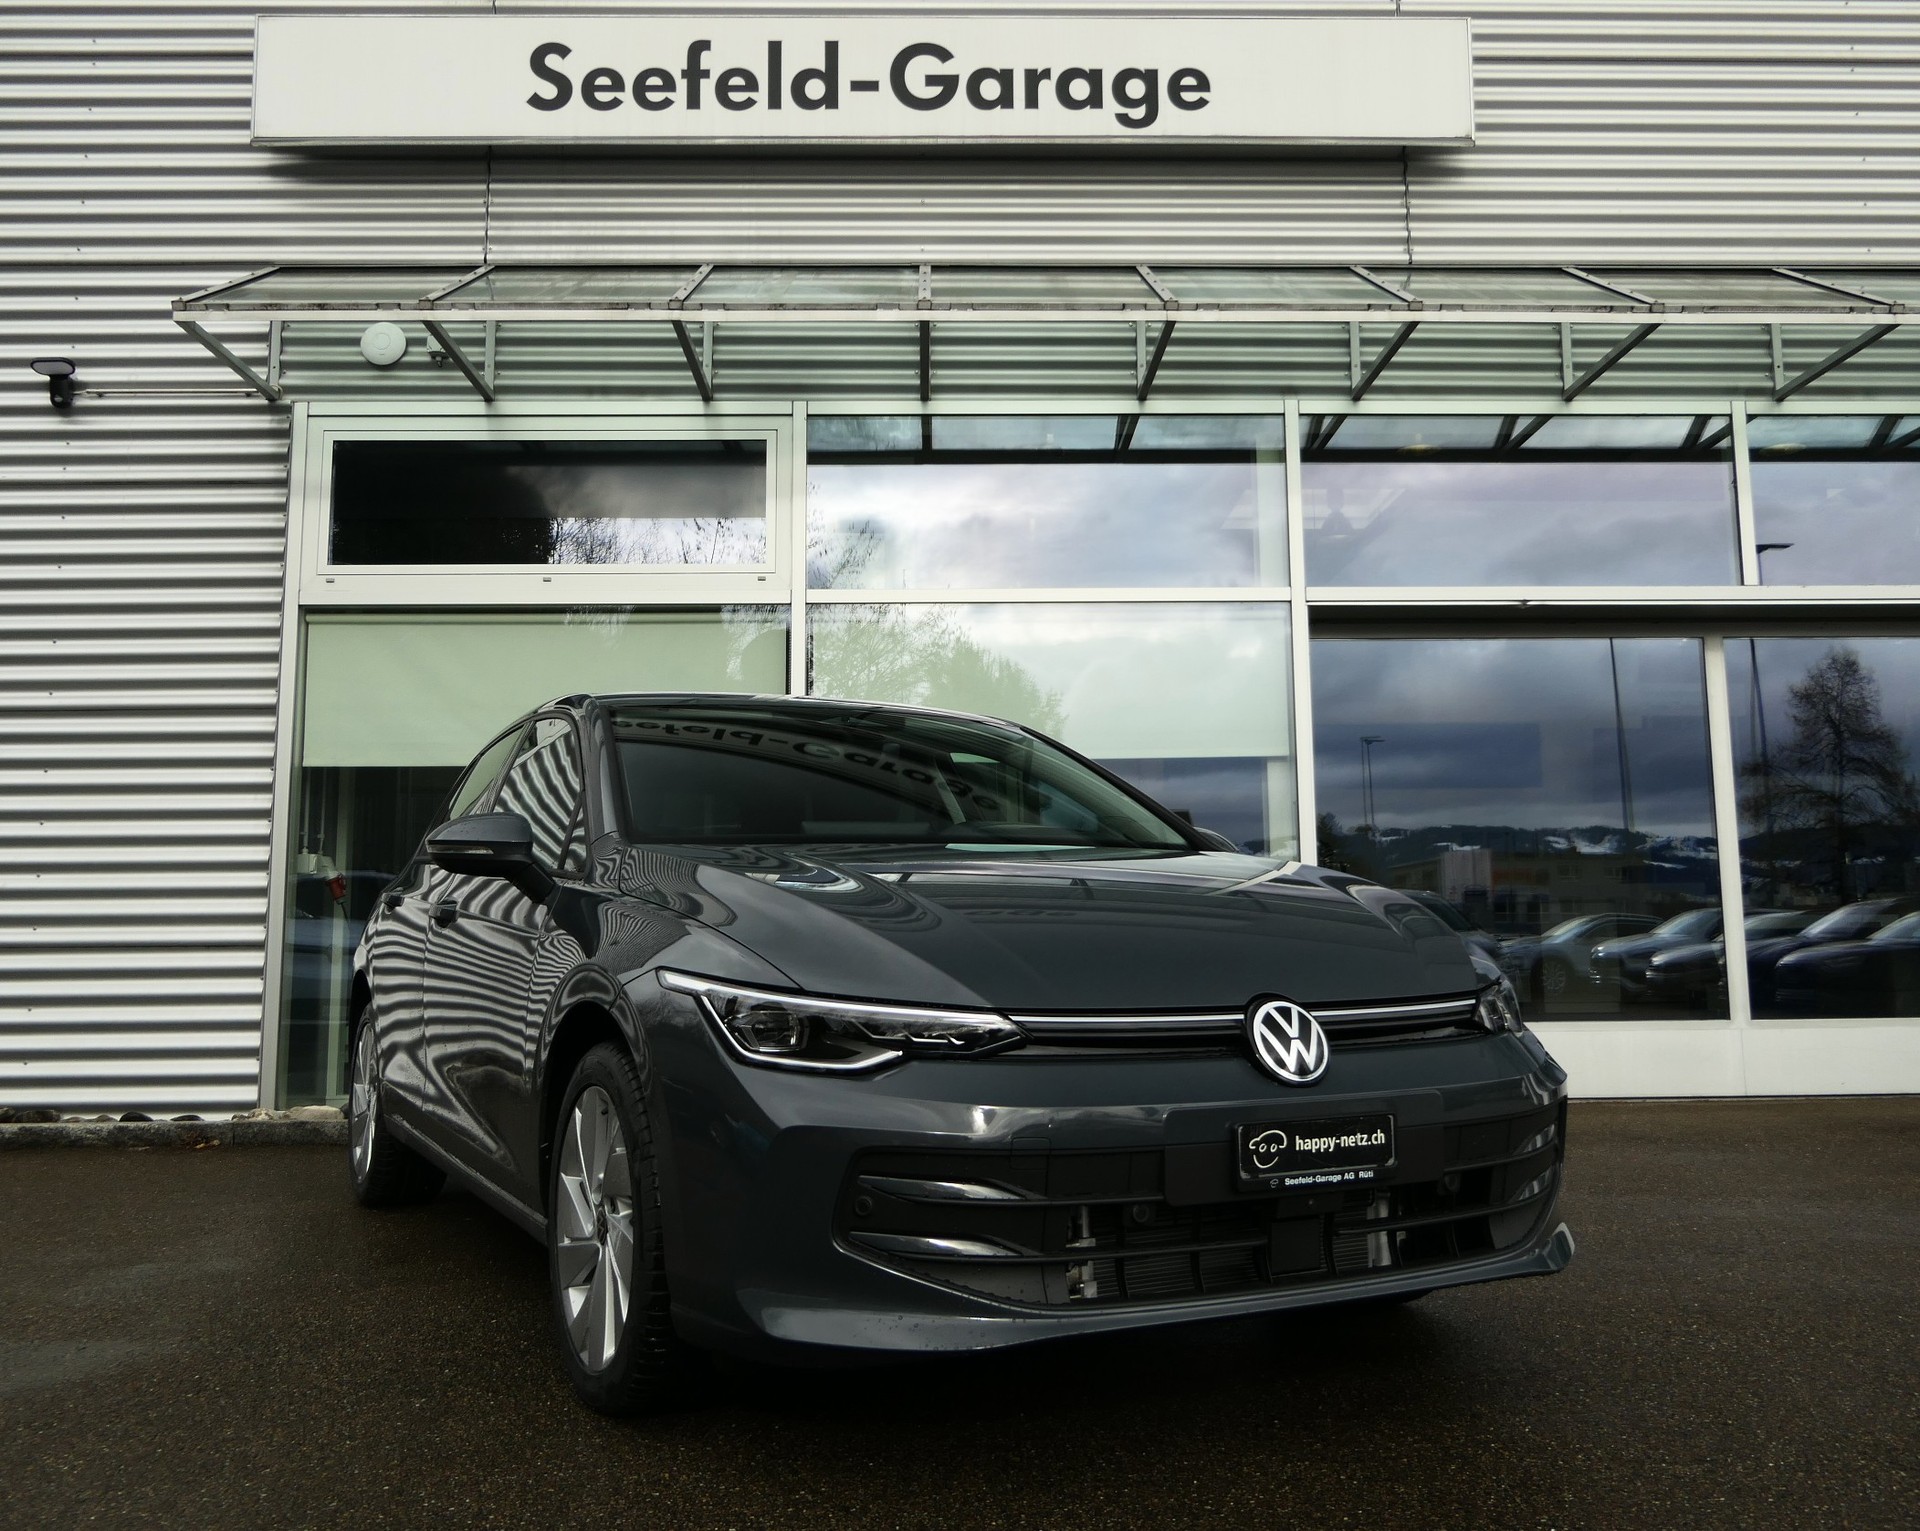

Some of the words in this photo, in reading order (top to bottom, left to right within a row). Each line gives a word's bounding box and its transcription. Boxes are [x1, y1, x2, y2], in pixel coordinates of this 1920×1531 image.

[527, 40, 1211, 128] Seefeld-Garage
[1256, 1004, 1325, 1077] VW
[1295, 1129, 1385, 1153] happy-netz.ch
[1284, 1173, 1342, 1186] Seefeld-Garage
[1343, 1171, 1355, 1180] AG
[1358, 1169, 1374, 1179] Rüti
